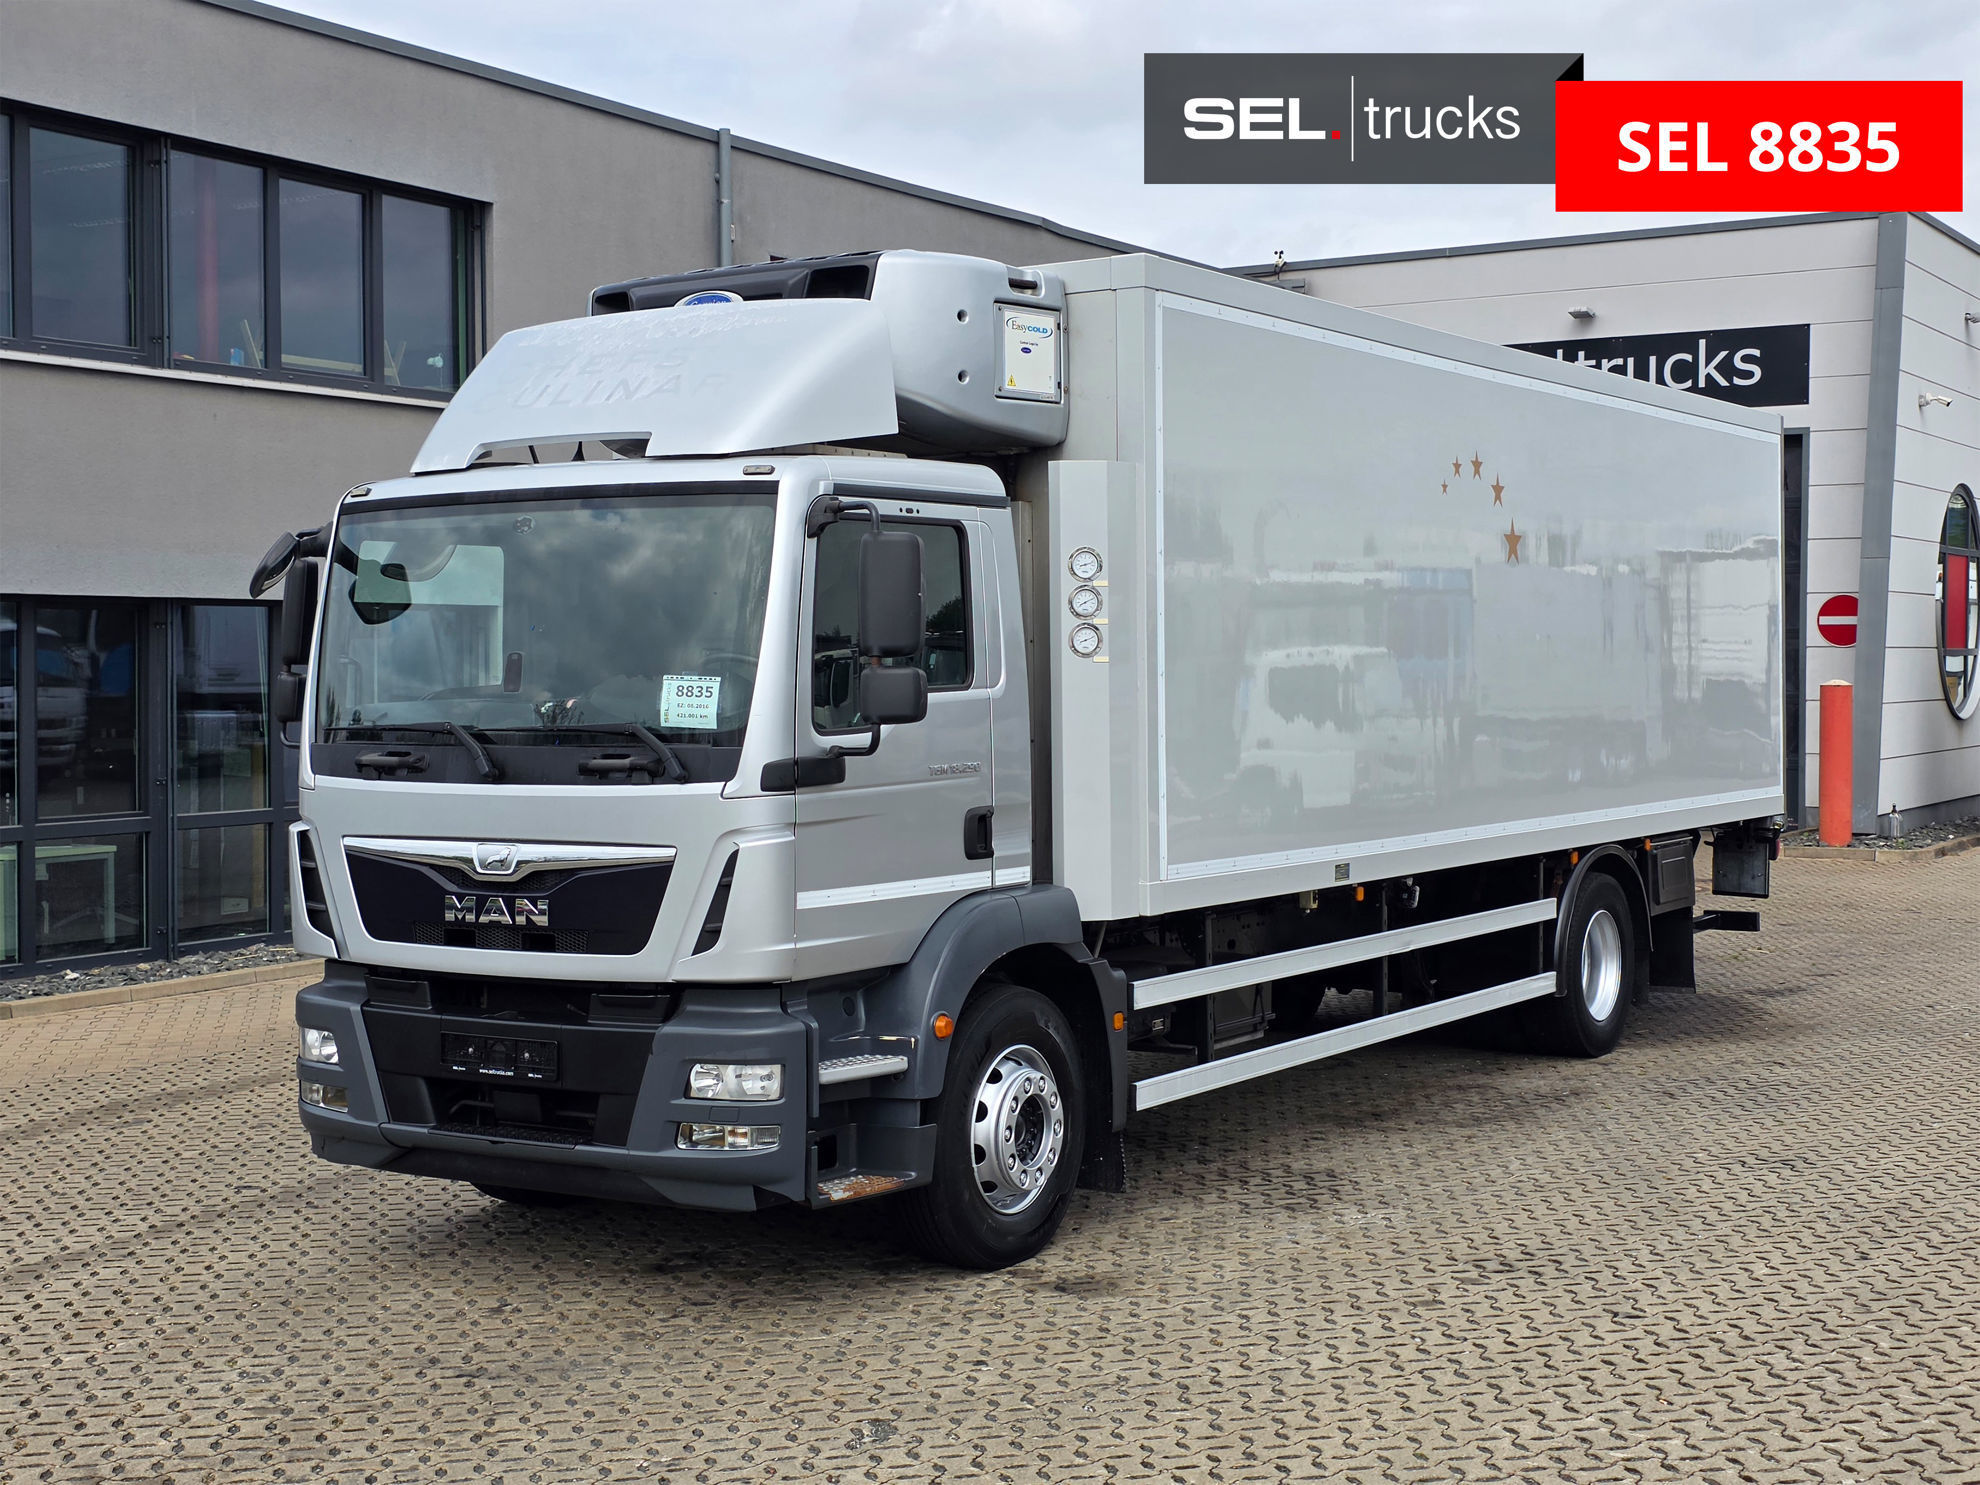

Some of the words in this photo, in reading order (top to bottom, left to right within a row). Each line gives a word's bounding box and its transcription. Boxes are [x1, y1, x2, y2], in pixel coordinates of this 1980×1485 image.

[1012, 319, 1048, 334] EasyCOLD
[675, 685, 714, 698] 8835
[445, 895, 549, 926] MAN
